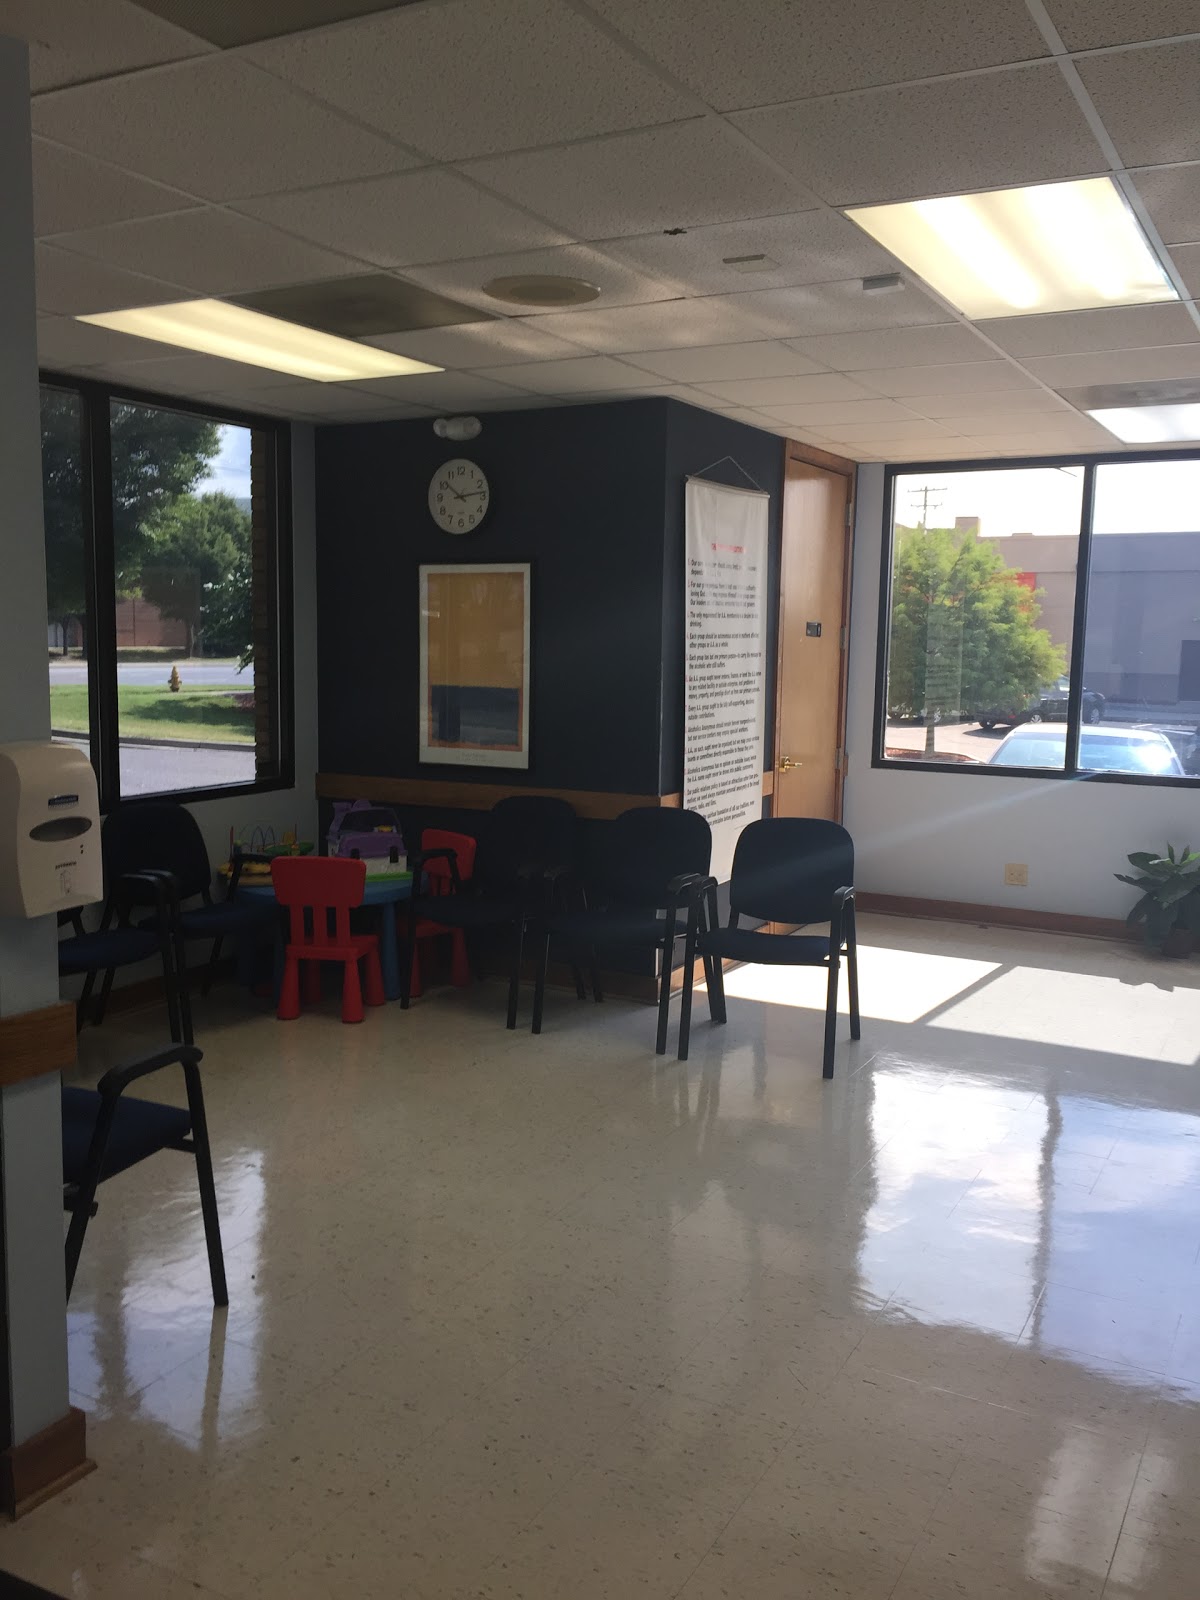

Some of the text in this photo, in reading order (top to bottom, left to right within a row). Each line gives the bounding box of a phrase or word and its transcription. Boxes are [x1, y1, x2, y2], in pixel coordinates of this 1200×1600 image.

[457, 466, 465, 475] 12
[470, 470, 474, 479] 1
[448, 471, 454, 480] 11
[440, 481, 449, 490] 10
[477, 480, 483, 488] 2
[437, 493, 443, 503] 9
[480, 492, 486, 501] 3
[440, 505, 446, 516] 8
[477, 505, 483, 514] 4
[448, 514, 453, 524] 7
[458, 518, 464, 527] 6
[469, 514, 475, 524] 5
